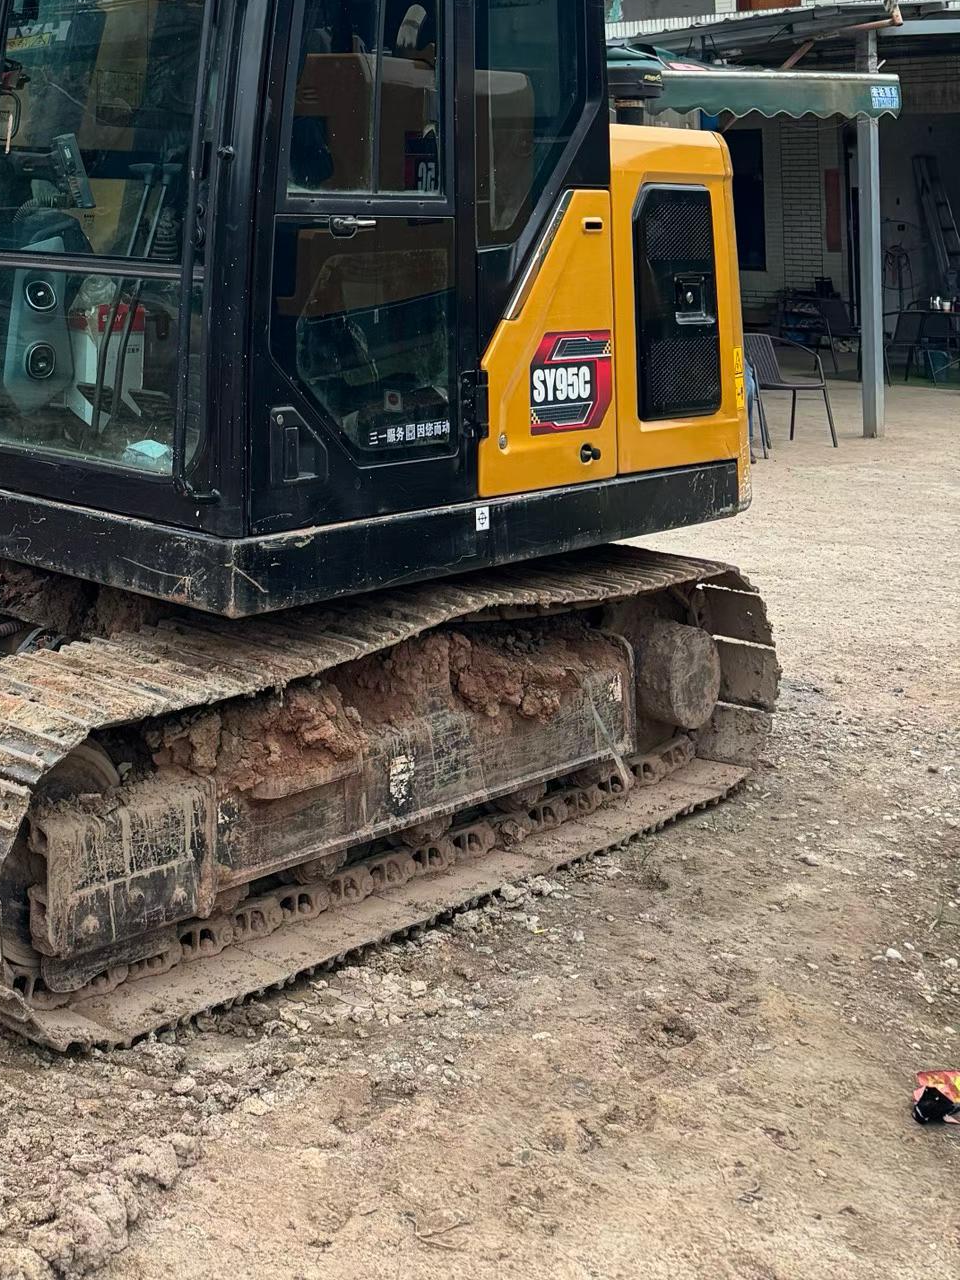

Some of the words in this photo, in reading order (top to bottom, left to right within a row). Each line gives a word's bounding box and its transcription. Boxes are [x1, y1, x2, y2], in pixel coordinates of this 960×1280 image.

[532, 365, 591, 403] SY95C
[368, 427, 404, 445] 三一服务
[416, 419, 450, 438] 因您而动
